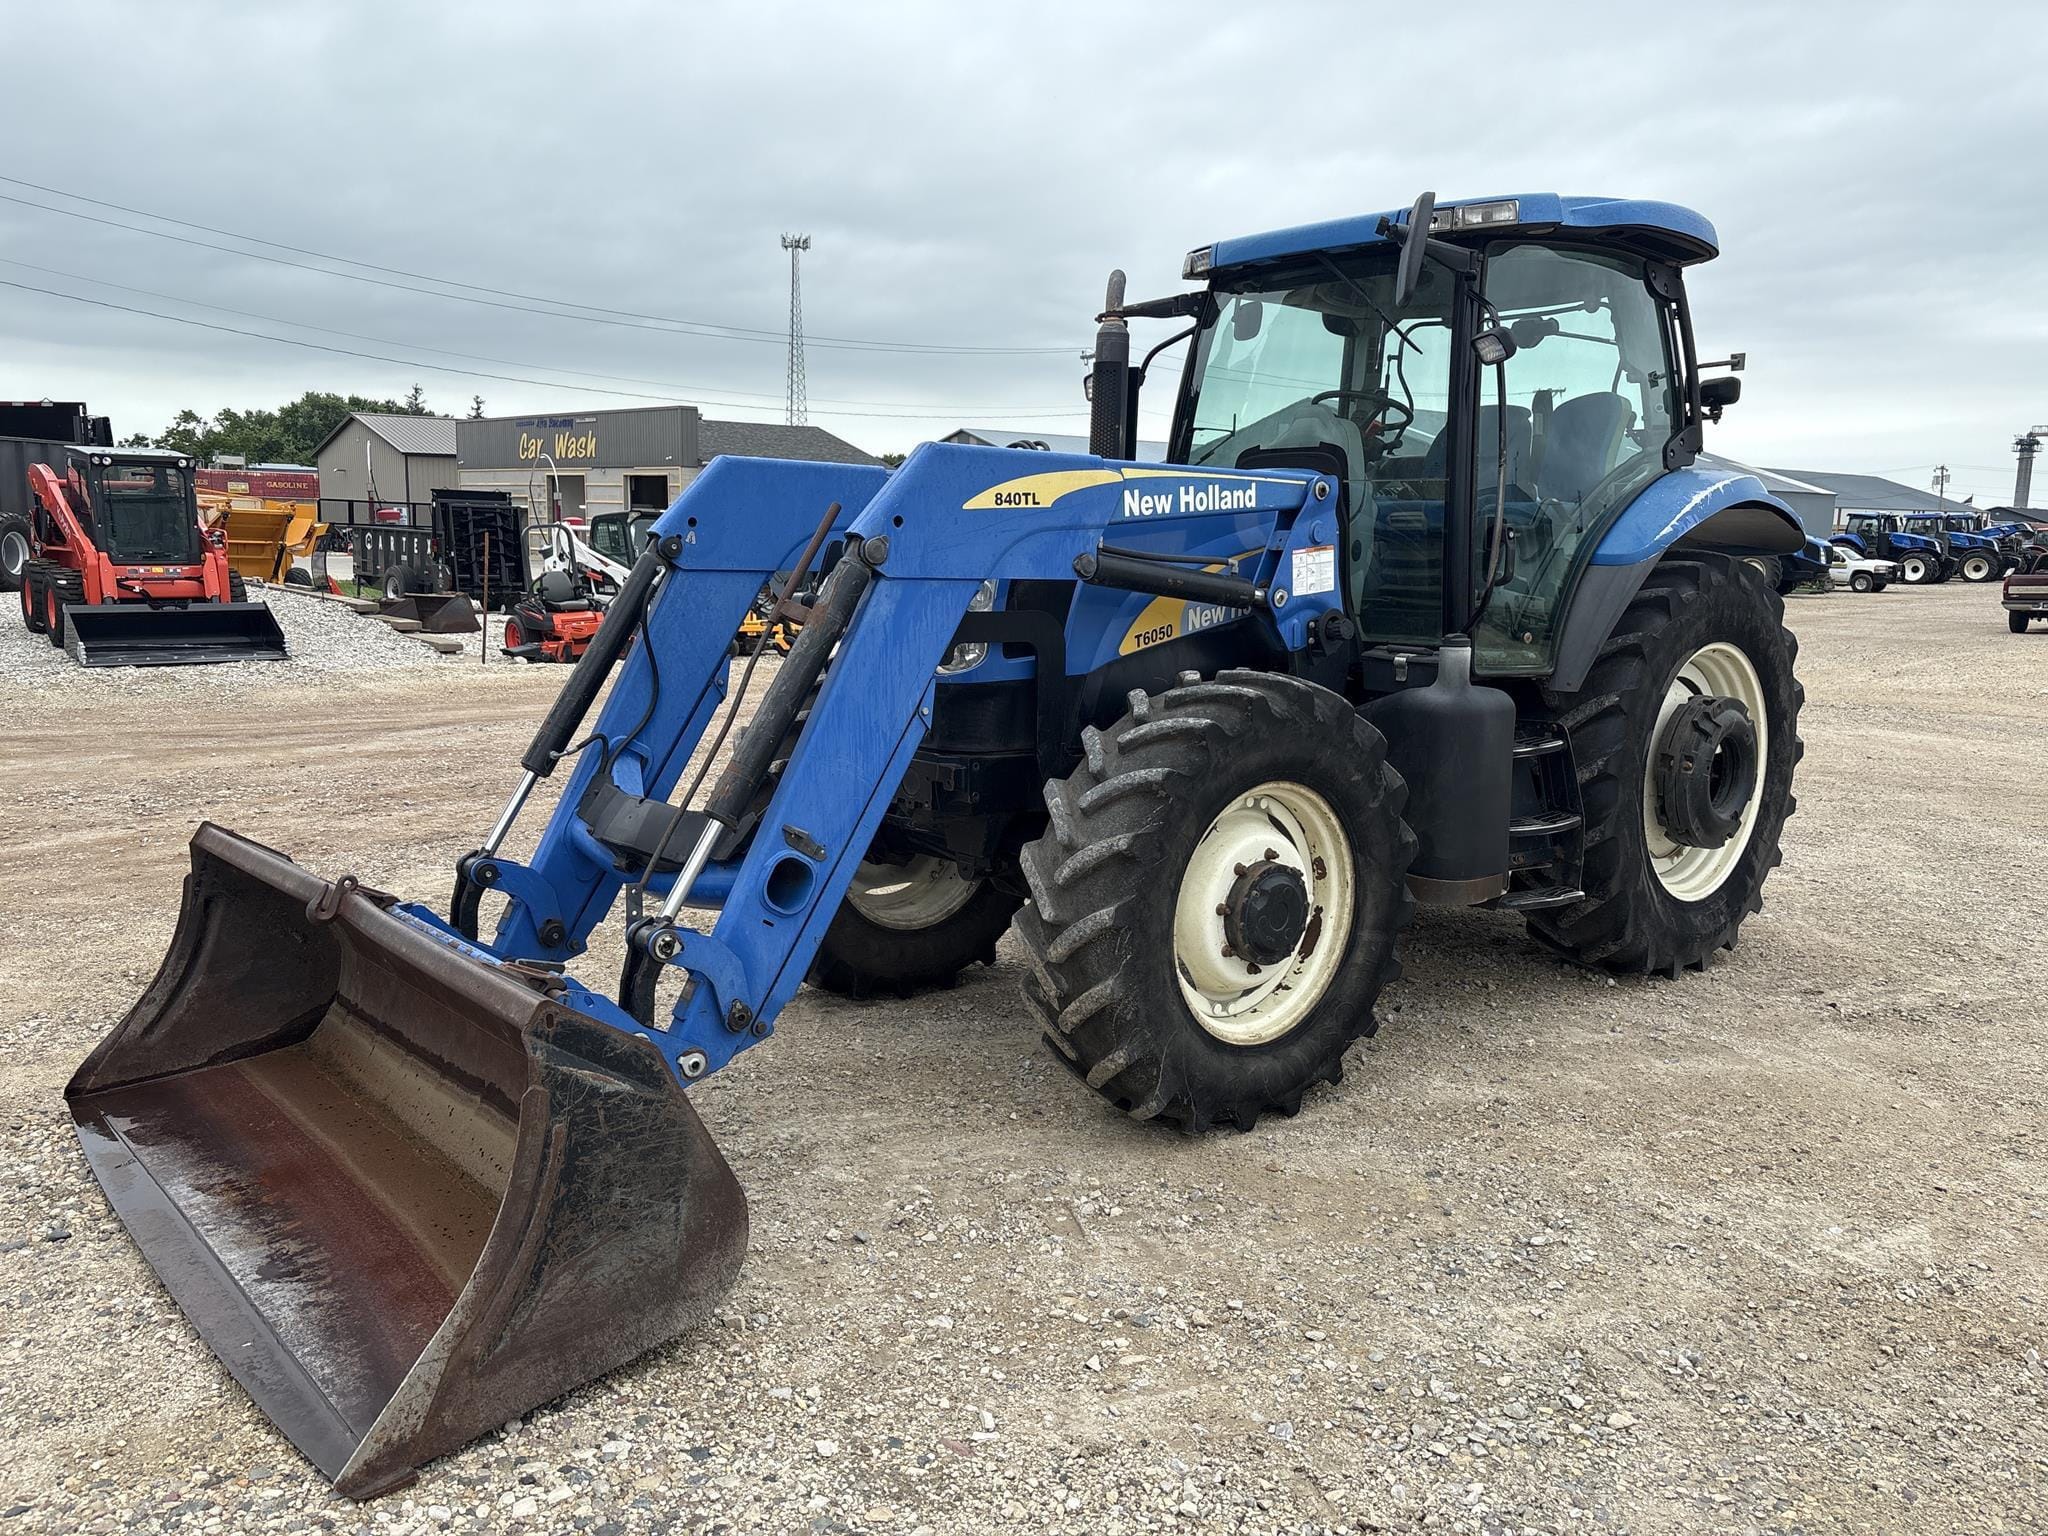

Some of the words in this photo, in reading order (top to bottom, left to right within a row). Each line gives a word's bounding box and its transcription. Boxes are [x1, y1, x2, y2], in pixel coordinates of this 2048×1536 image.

[520, 432, 543, 459] Car
[555, 430, 596, 459] Wash
[266, 481, 308, 489] GASOLINE
[995, 492, 1040, 505] 840TL
[1123, 489, 1172, 517] New
[1180, 482, 1256, 512] Holland
[1188, 606, 1225, 631] New
[1135, 624, 1172, 648] T6050
